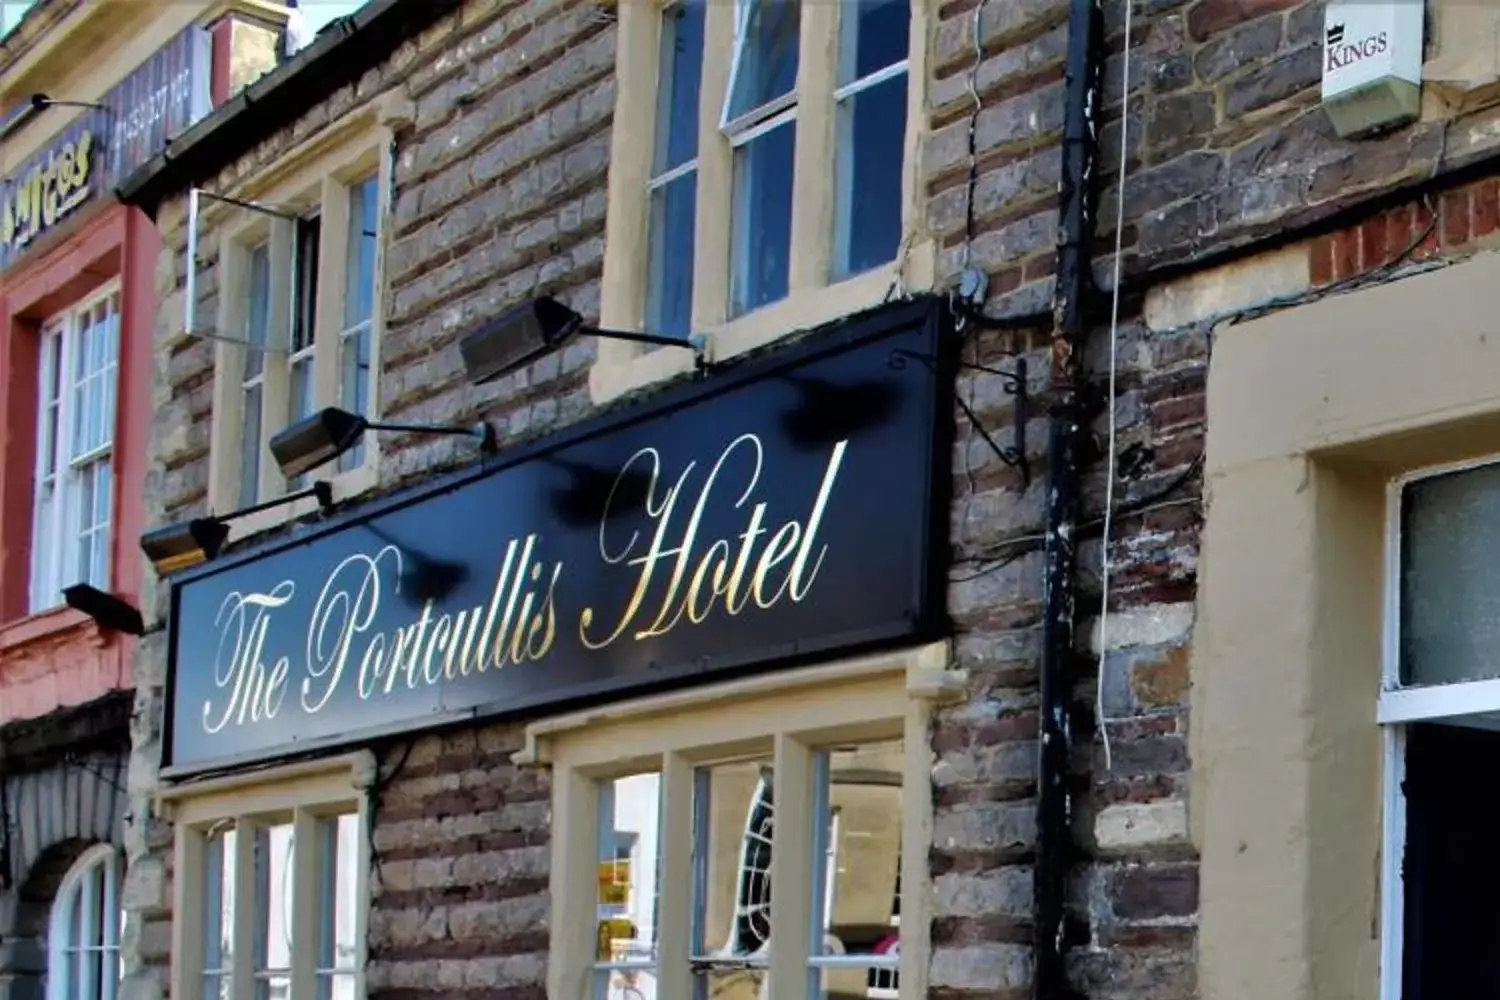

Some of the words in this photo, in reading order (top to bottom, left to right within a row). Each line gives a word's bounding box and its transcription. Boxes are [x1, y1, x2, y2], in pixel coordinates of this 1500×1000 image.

[1327, 31, 1387, 72] KINGS
[203, 578, 296, 734] The
[302, 534, 563, 714] Portcullis
[580, 433, 849, 650] Hotel
